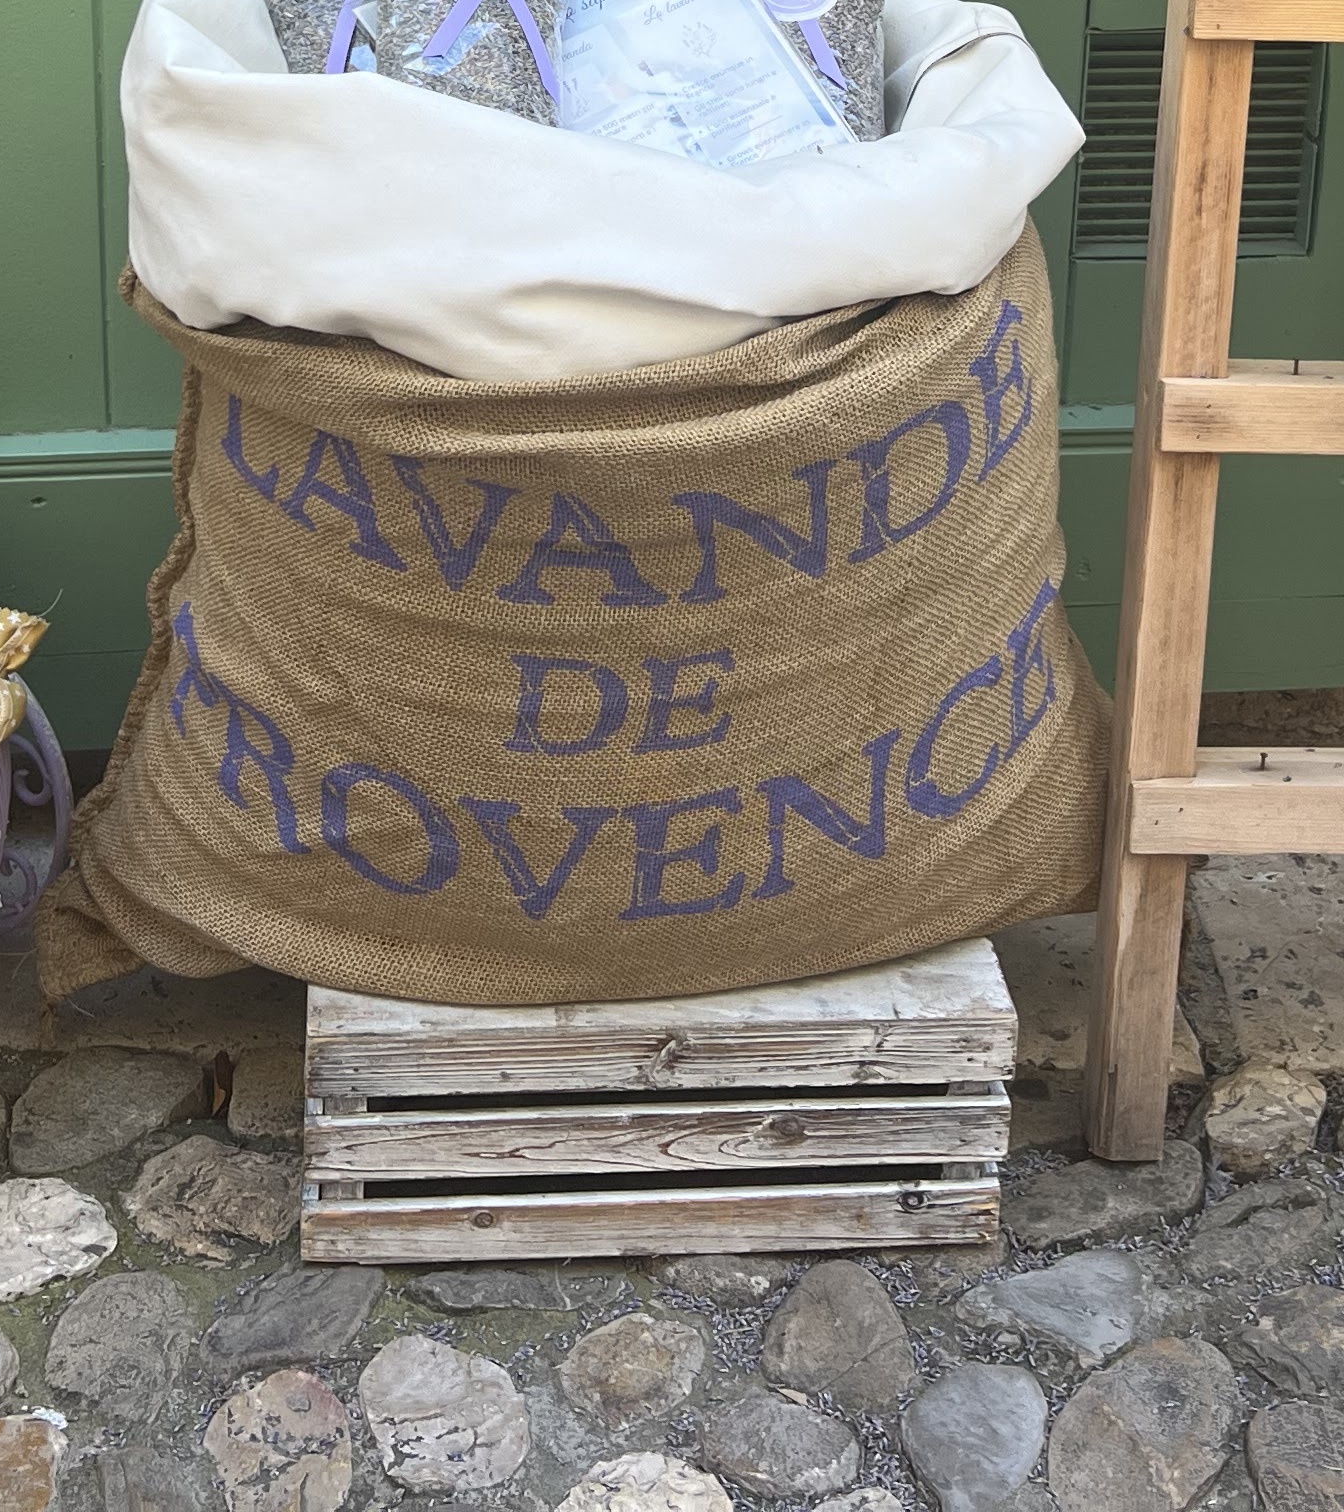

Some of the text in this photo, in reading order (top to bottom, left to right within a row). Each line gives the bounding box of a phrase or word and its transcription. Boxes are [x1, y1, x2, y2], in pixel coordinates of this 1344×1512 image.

[561, 40, 594, 62] vanda
[220, 298, 1036, 608] LAVANDE
[506, 648, 736, 756] DE
